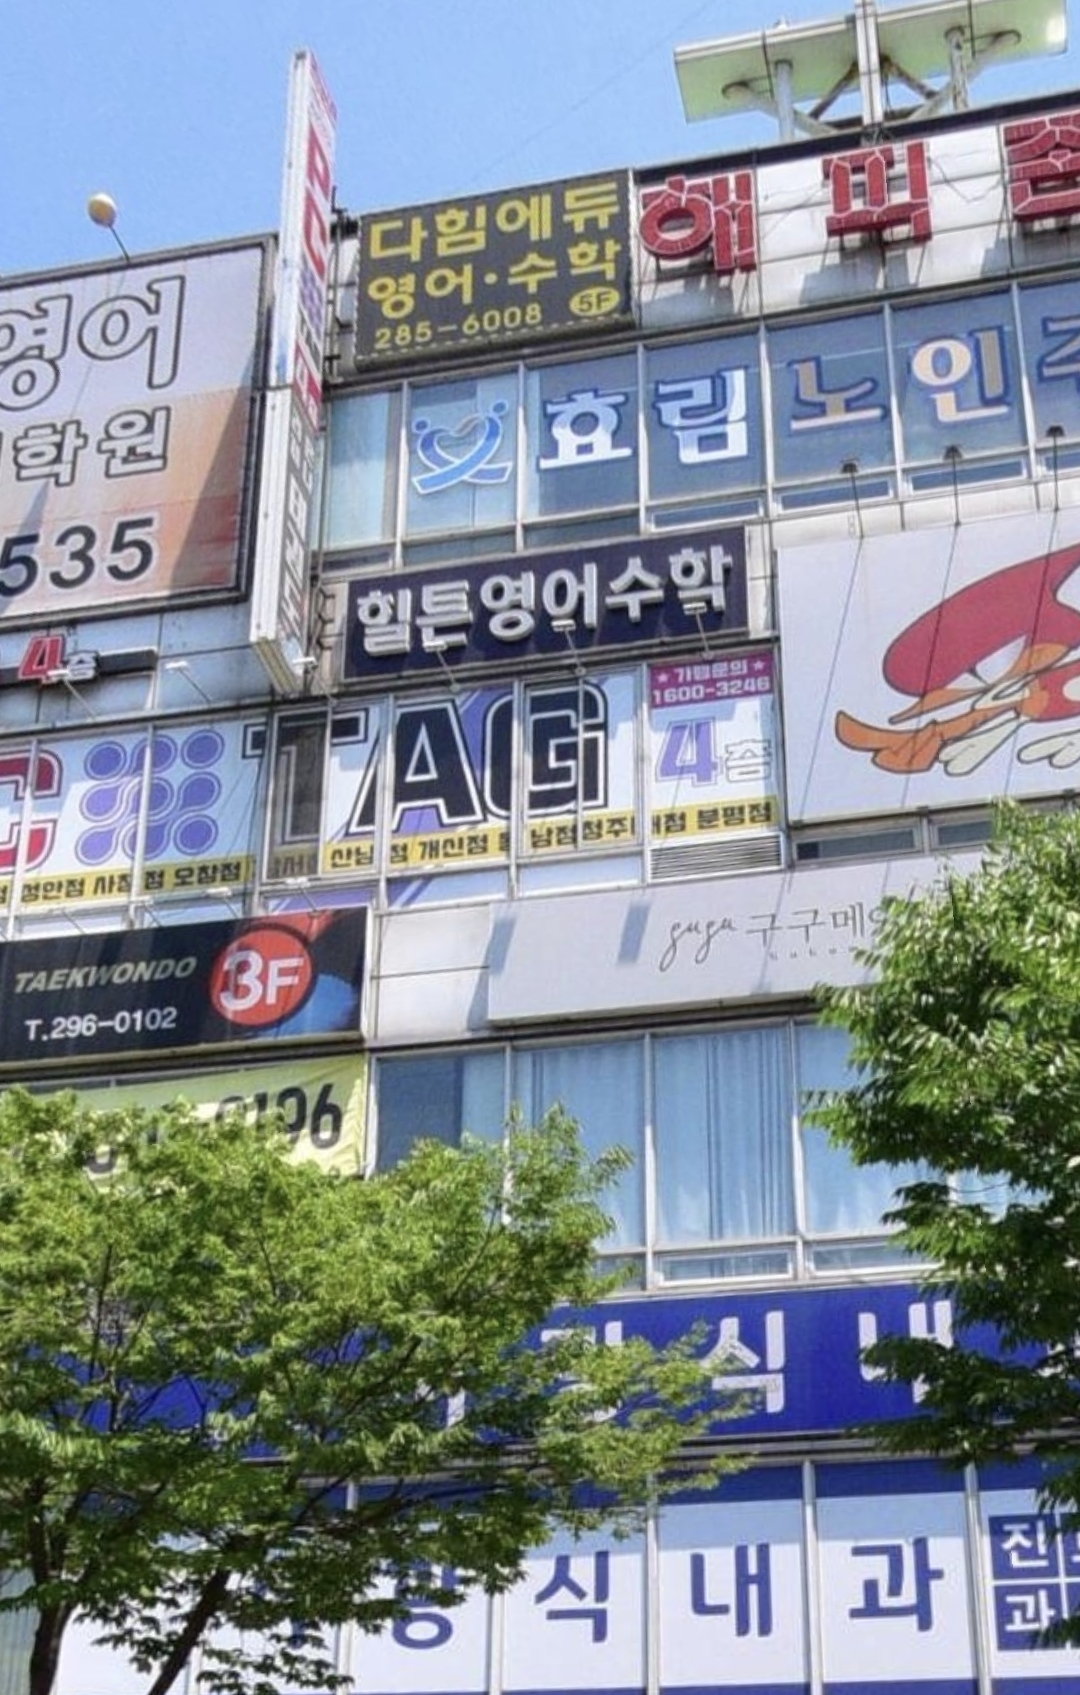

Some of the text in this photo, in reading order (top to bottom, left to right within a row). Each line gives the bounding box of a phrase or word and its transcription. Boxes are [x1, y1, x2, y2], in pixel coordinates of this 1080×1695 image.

[368, 182, 620, 262] 다힘에듀
[374, 303, 543, 349] 285-6008
[577, 294, 612, 312] 5F
[12, 406, 171, 487] 학원
[356, 545, 732, 657] 힐든영어수학
[18, 634, 97, 685] 4층
[653, 676, 771, 705] 1600-3246
[656, 717, 772, 787] 4층
[697, 801, 772, 829] 분평점
[14, 956, 197, 994] TAEKWONDO
[219, 950, 305, 1012] 3F
